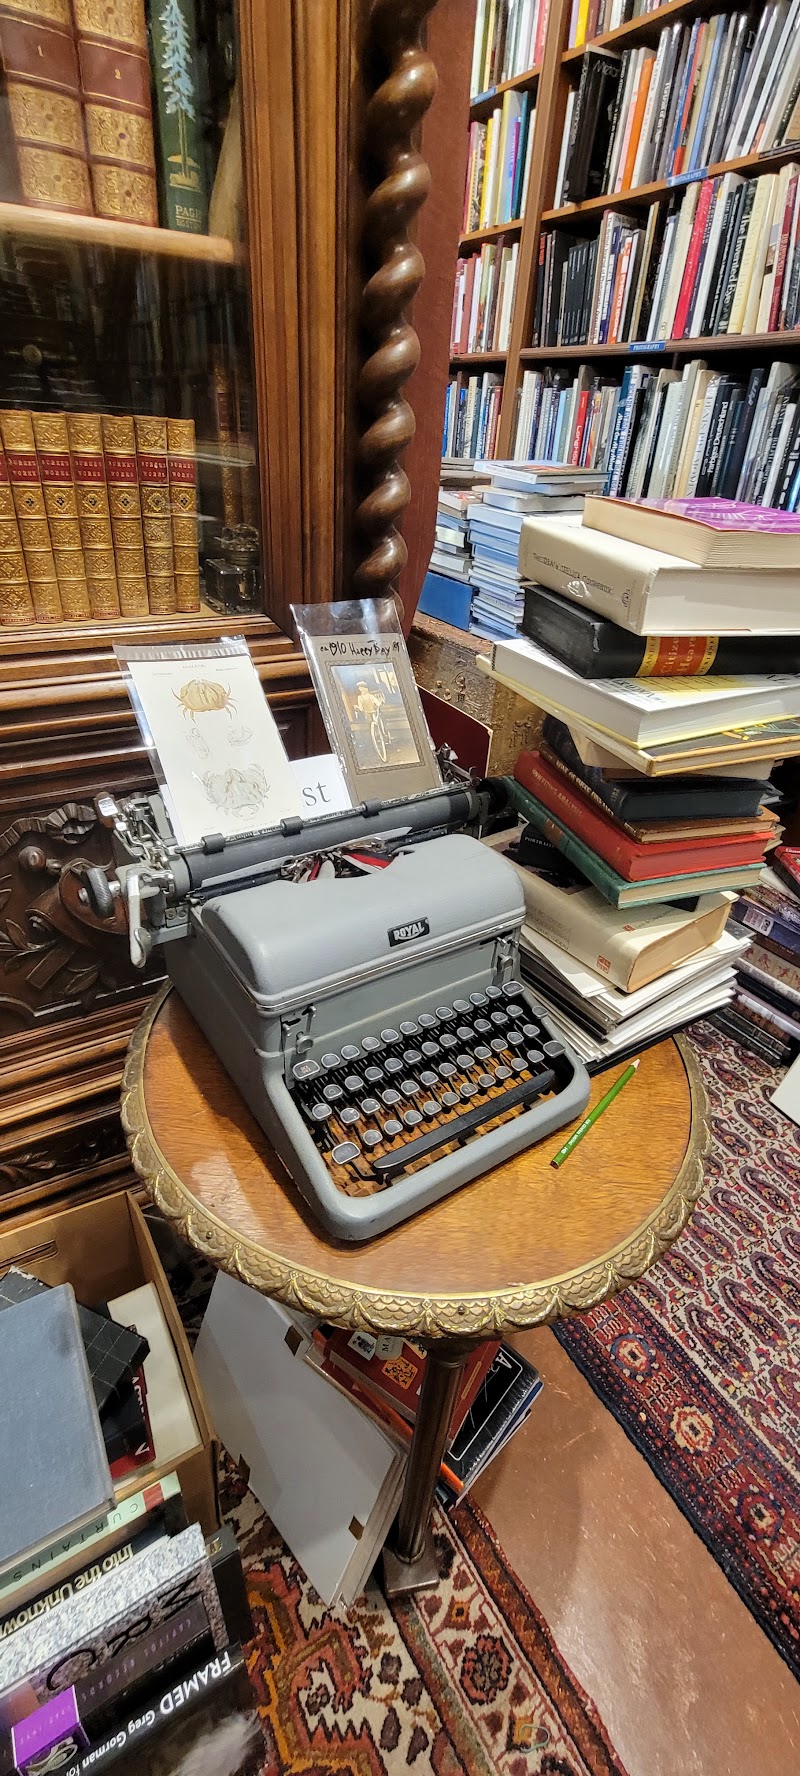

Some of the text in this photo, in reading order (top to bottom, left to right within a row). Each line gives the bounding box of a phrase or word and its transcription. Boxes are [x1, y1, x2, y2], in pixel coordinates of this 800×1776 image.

[659, 81, 671, 110] Portrait
[652, 130, 661, 144] Age
[722, 210, 751, 305] The Invented Eye
[611, 273, 626, 337] PHOTO ICONS
[624, 382, 635, 408] RICHARD
[620, 410, 630, 432] AVEDON
[699, 395, 713, 430] DENIS
[712, 400, 729, 446] Deutschland
[570, 424, 582, 465] LongHou
[614, 434, 625, 461] EVIDENCE
[706, 445, 719, 473] Farbiges
[607, 453, 616, 471] Mind
[660, 636, 680, 676] Citize
[676, 636, 697, 674] Hears
[302, 781, 332, 808] st
[392, 922, 425, 942] ROYAL
[12, 1502, 139, 1582] CURTAINS
[101, 1542, 135, 1570] Into
[74, 1560, 102, 1589] the
[79, 1618, 193, 1702] CAPITOL RECORDS
[159, 1651, 232, 1715] FRAMED
[127, 1709, 156, 1735] Greg
[82, 1731, 127, 1772] Gorman
